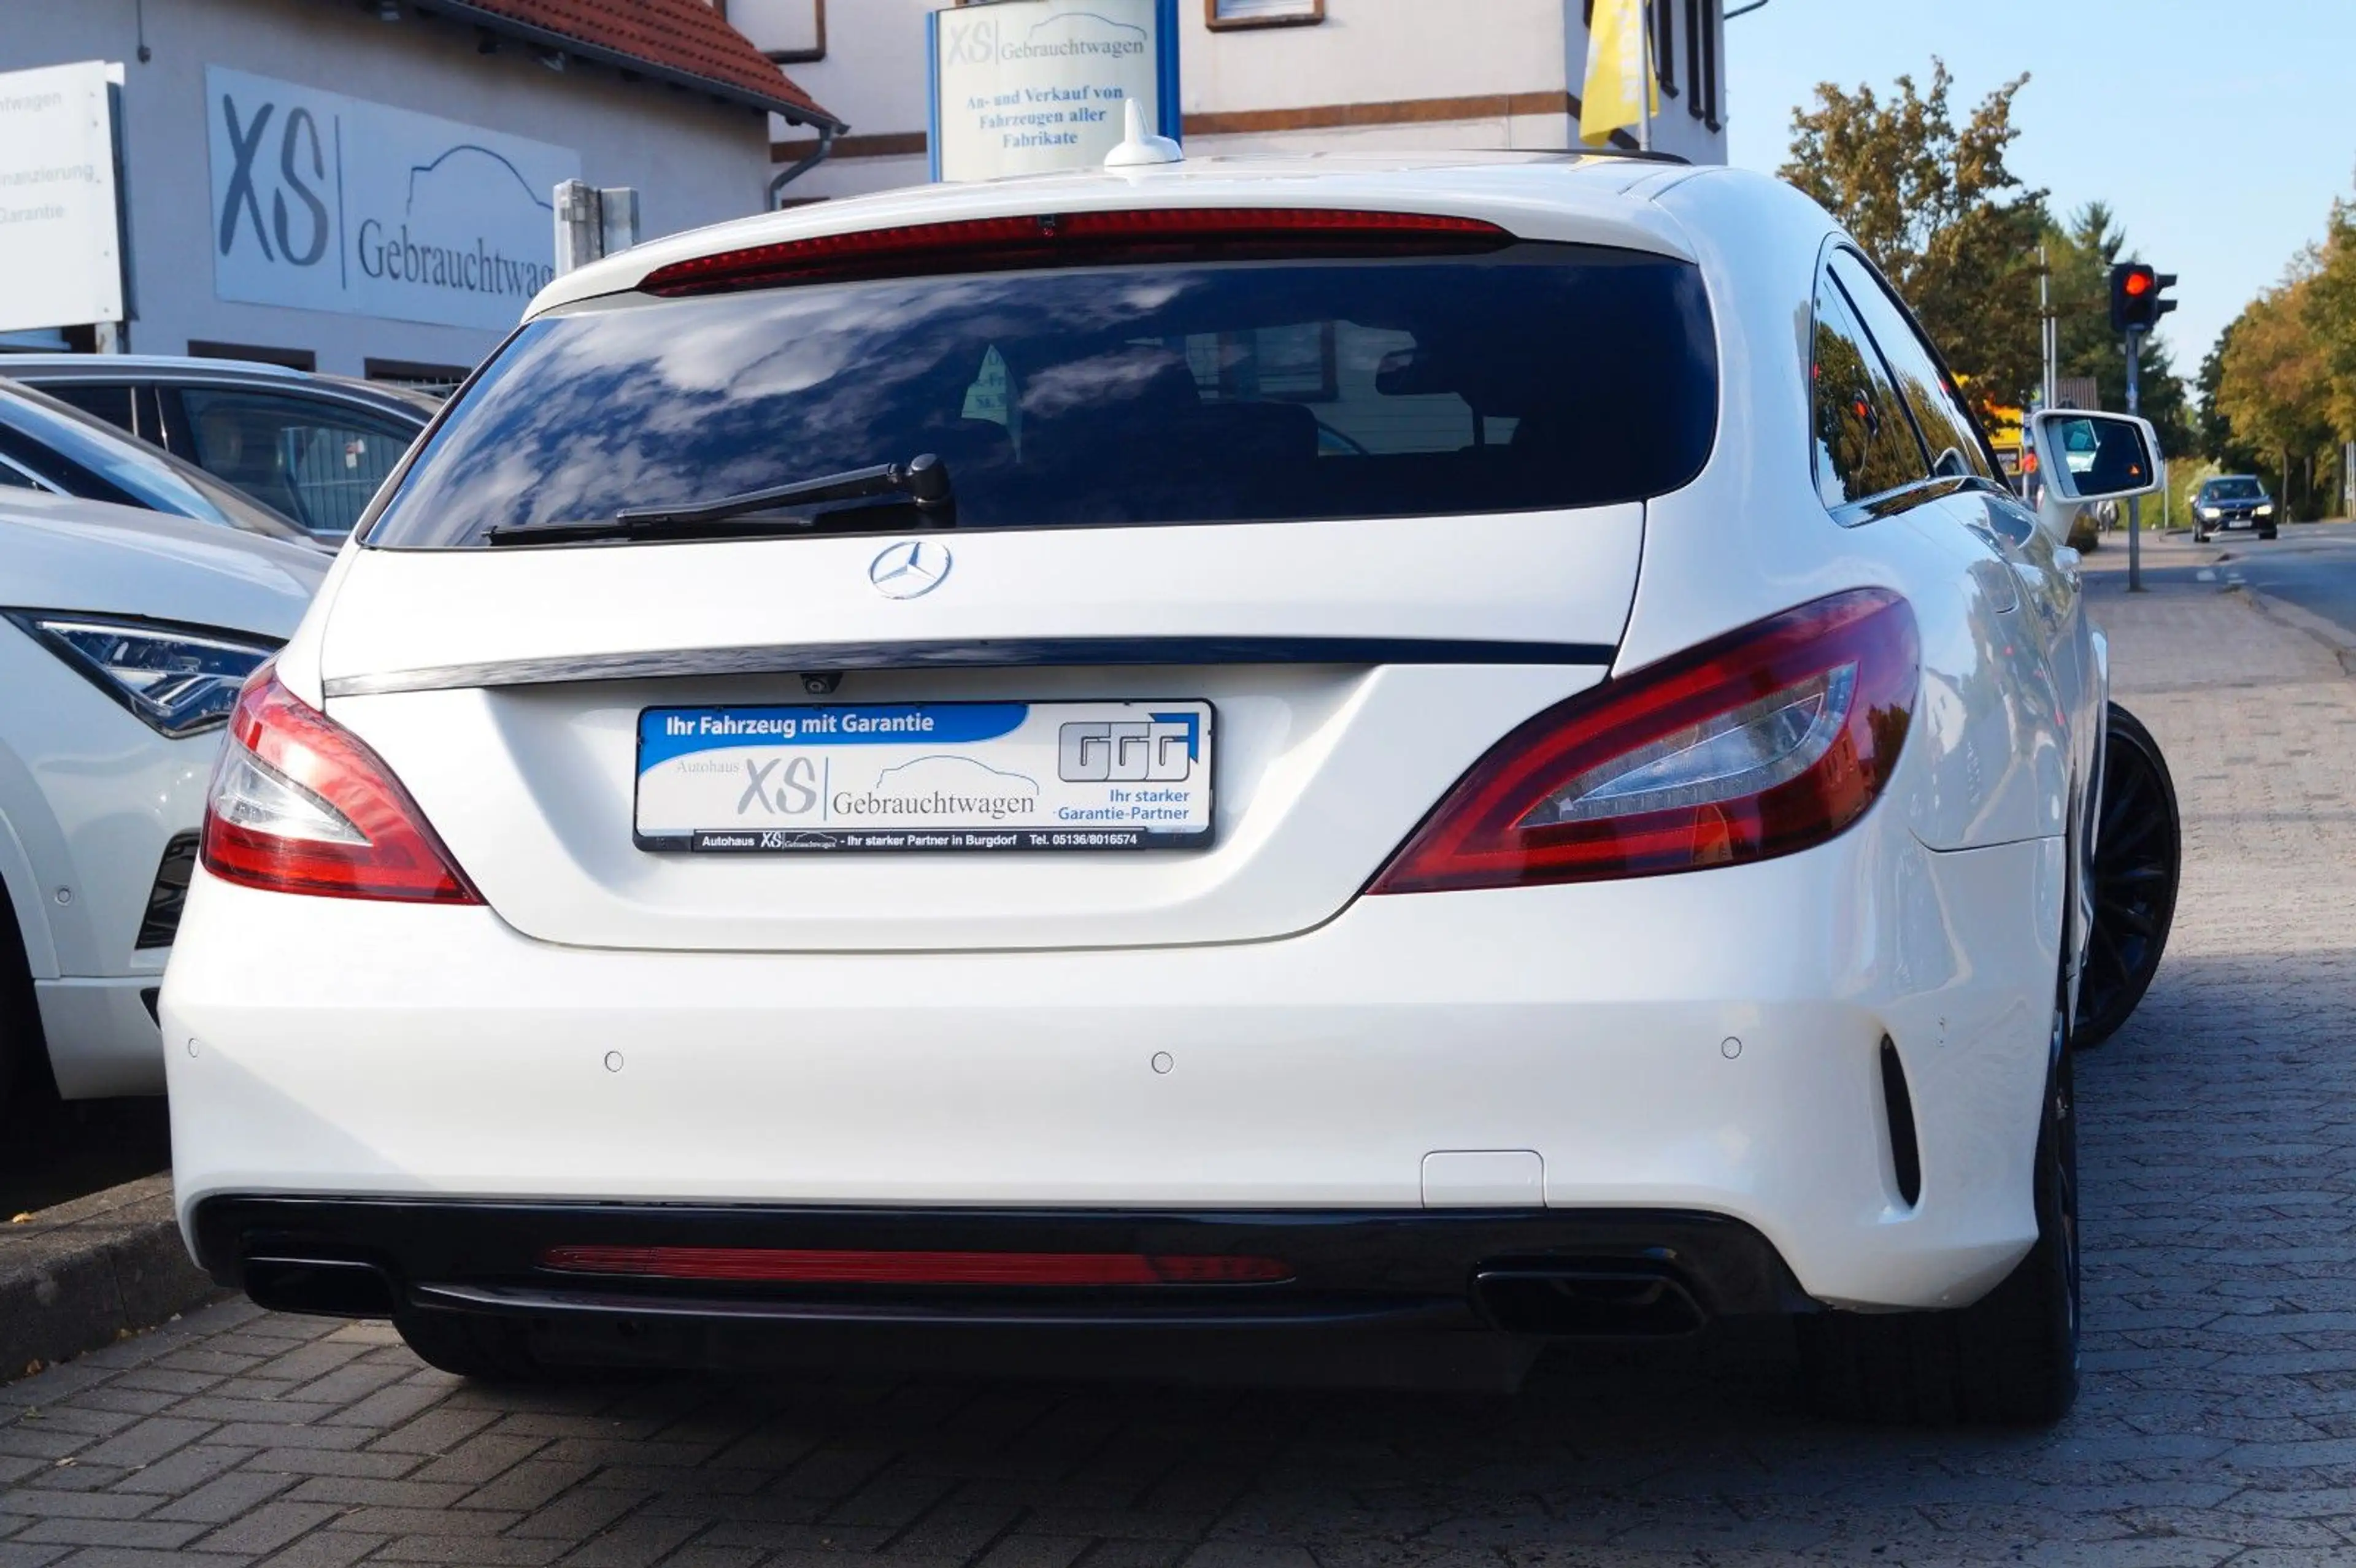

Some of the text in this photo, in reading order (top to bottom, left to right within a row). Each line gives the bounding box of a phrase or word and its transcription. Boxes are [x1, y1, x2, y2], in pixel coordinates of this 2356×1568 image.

[948, 20, 1145, 66] XS Gebrauchtwagen
[966, 85, 1123, 110] An- und Verkauf von
[979, 107, 1107, 129] Fahrzeugen aller
[1003, 132, 1079, 149] Fabrikate
[219, 93, 328, 266] XS
[666, 713, 934, 739] Ihr Fahrzeug mit Garantie
[677, 759, 739, 774] Autohaus
[737, 757, 1034, 820] XS Gebrauchtwagen
[1110, 789, 1190, 802] Ihr starker
[1058, 806, 1189, 821] Garantie-Partner
[702, 836, 755, 847] Autohaus
[760, 831, 782, 848] XS
[847, 835, 863, 846] Ihr
[866, 835, 905, 846] starker
[907, 834, 950, 846] Partner
[952, 834, 963, 845] in
[966, 834, 1018, 848] Burgdorf
[1030, 834, 1050, 845] Tel.
[1052, 833, 1138, 845] 05136/8016574
